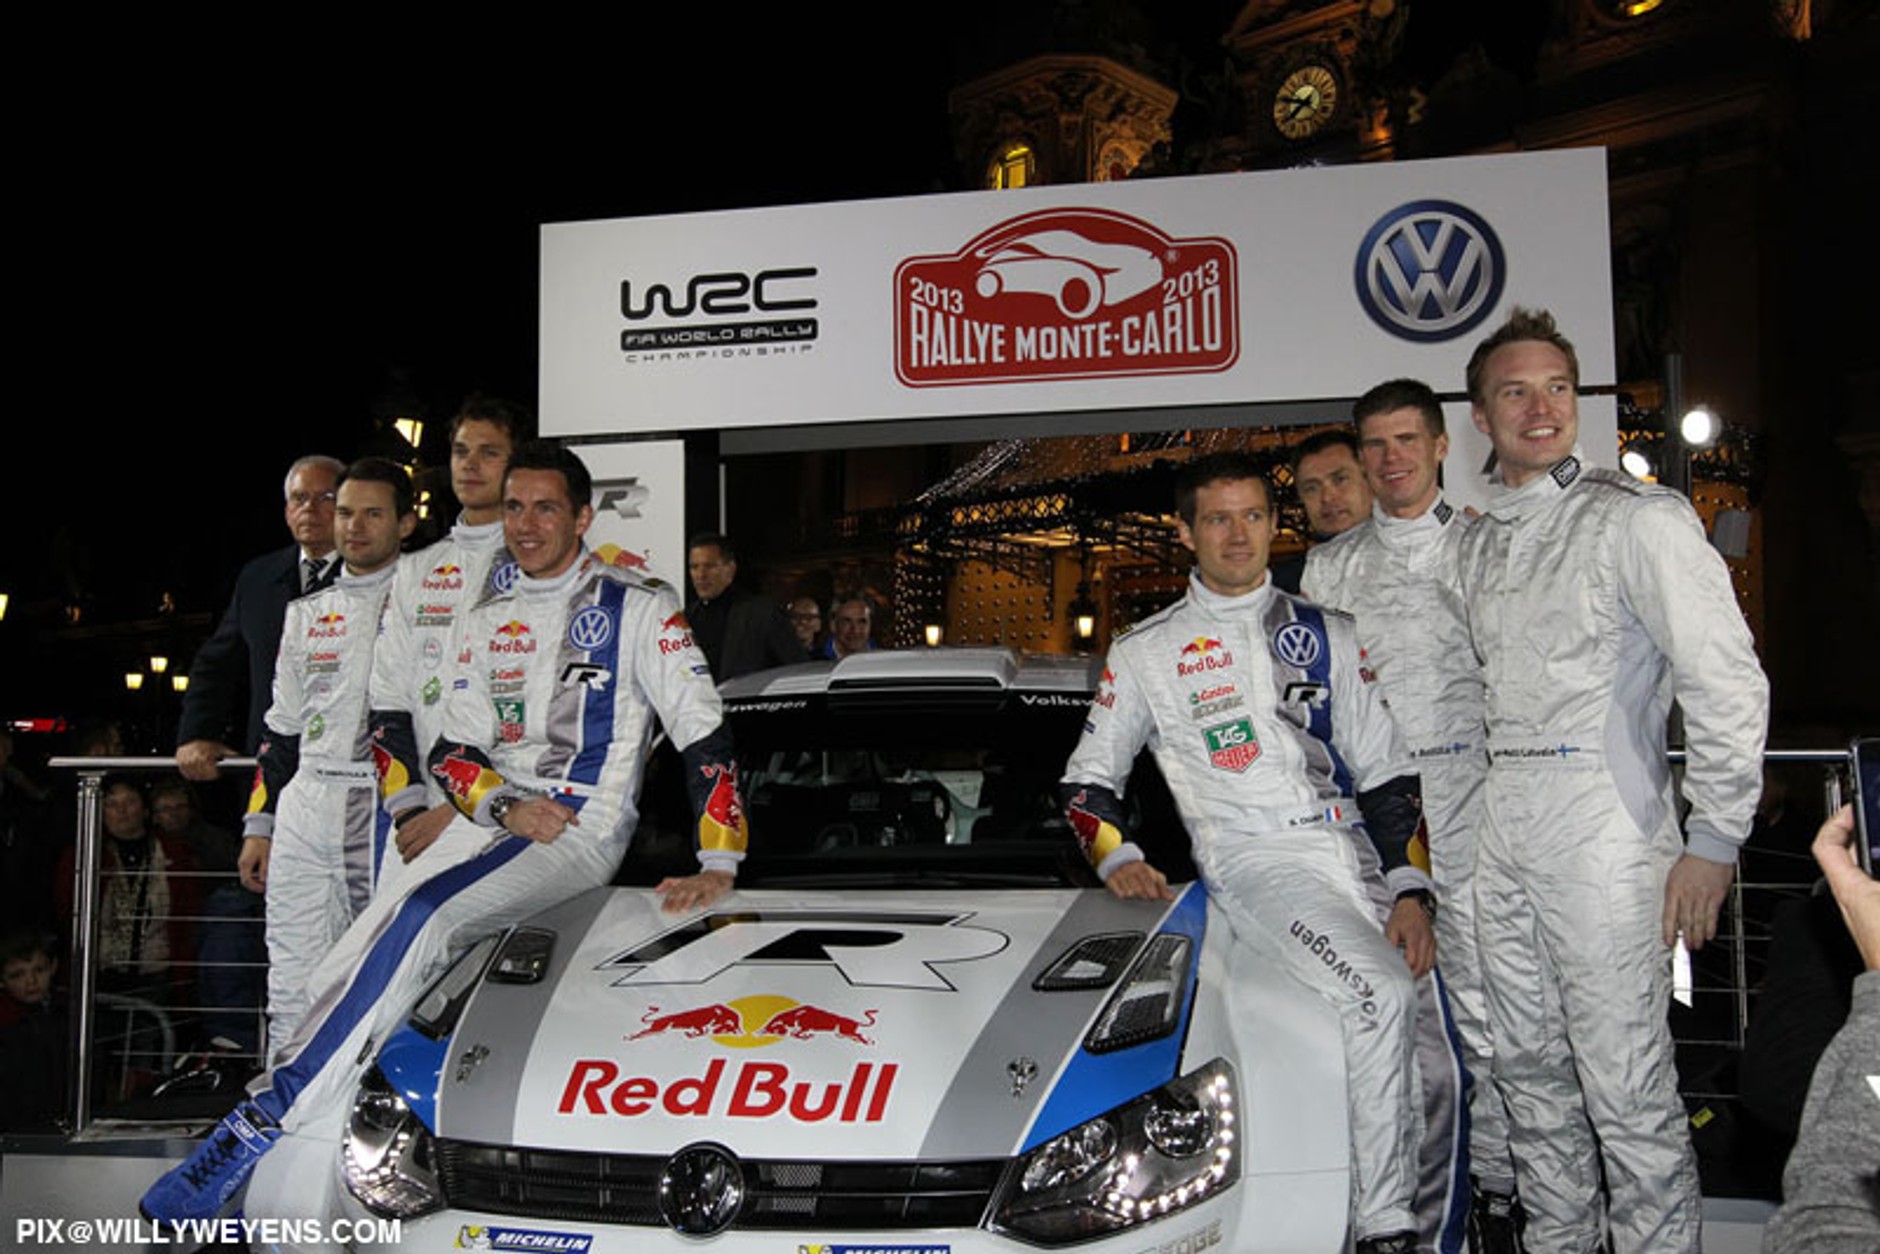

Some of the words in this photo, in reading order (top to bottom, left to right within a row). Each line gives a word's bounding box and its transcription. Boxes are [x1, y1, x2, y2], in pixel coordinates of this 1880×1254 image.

[621, 267, 818, 320] WRC
[1163, 259, 1219, 304] 2013
[909, 276, 964, 315] 2013
[625, 334, 657, 346] FIA
[661, 328, 735, 345] WORLD
[740, 323, 812, 340] RALLY
[911, 302, 1006, 368] RALLYE
[625, 344, 813, 363] CHAMPIONSHIP
[658, 632, 692, 656] Red
[1177, 657, 1205, 677] Red
[1205, 650, 1234, 672] Bull
[722, 701, 807, 713] swagen
[1020, 694, 1094, 706] Volksw
[1212, 724, 1248, 749] TAG
[557, 1059, 727, 1117] Red
[726, 1062, 899, 1122] Bull
[494, 1233, 589, 1251] MICHELIN
